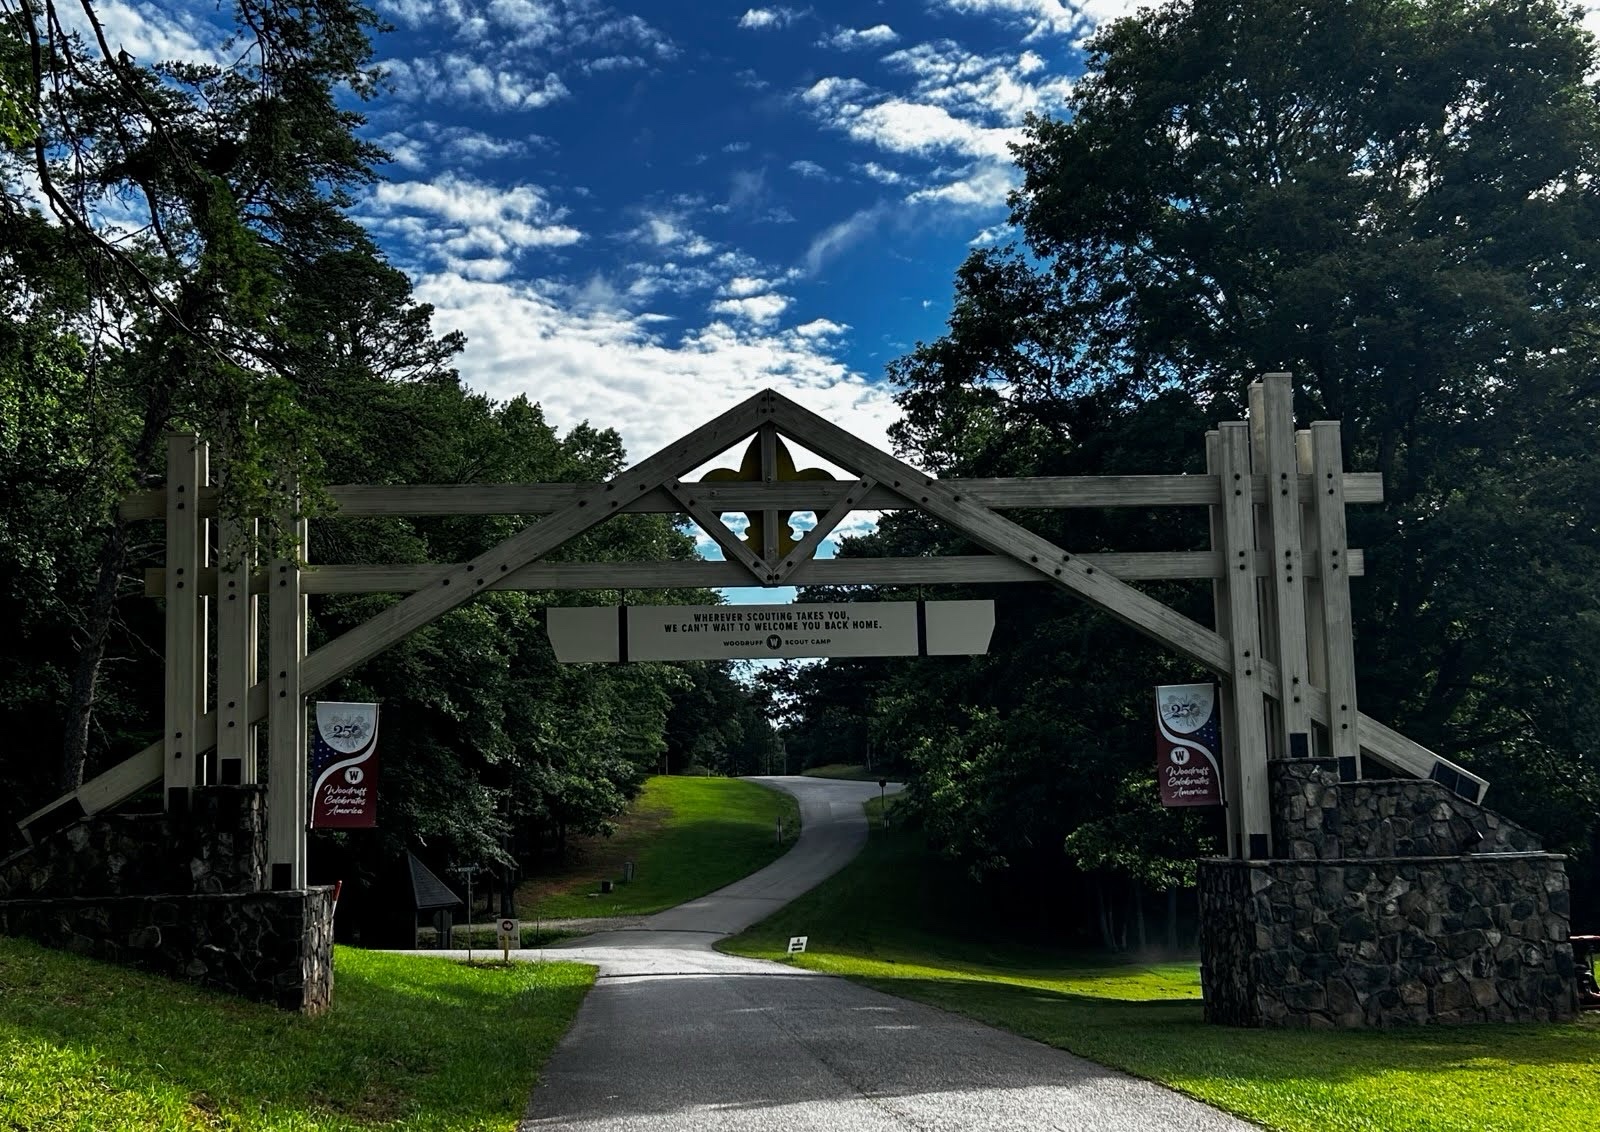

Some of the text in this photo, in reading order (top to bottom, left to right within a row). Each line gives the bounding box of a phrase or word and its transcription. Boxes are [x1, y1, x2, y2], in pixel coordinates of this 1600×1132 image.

[693, 611, 850, 622] WHEREVER SCOUTING TAKES YOU,
[664, 620, 882, 632] WE CAN'T WAIT TO WELCOME YOU BACK HOME.
[1174, 750, 1185, 761] W
[348, 770, 360, 781] W
[1165, 766, 1209, 777] Woodruff
[1167, 777, 1209, 787] Celebrates
[324, 784, 367, 796] Woodruff
[1171, 787, 1208, 798] America
[324, 795, 366, 805] Celebrates
[325, 805, 363, 815] America
